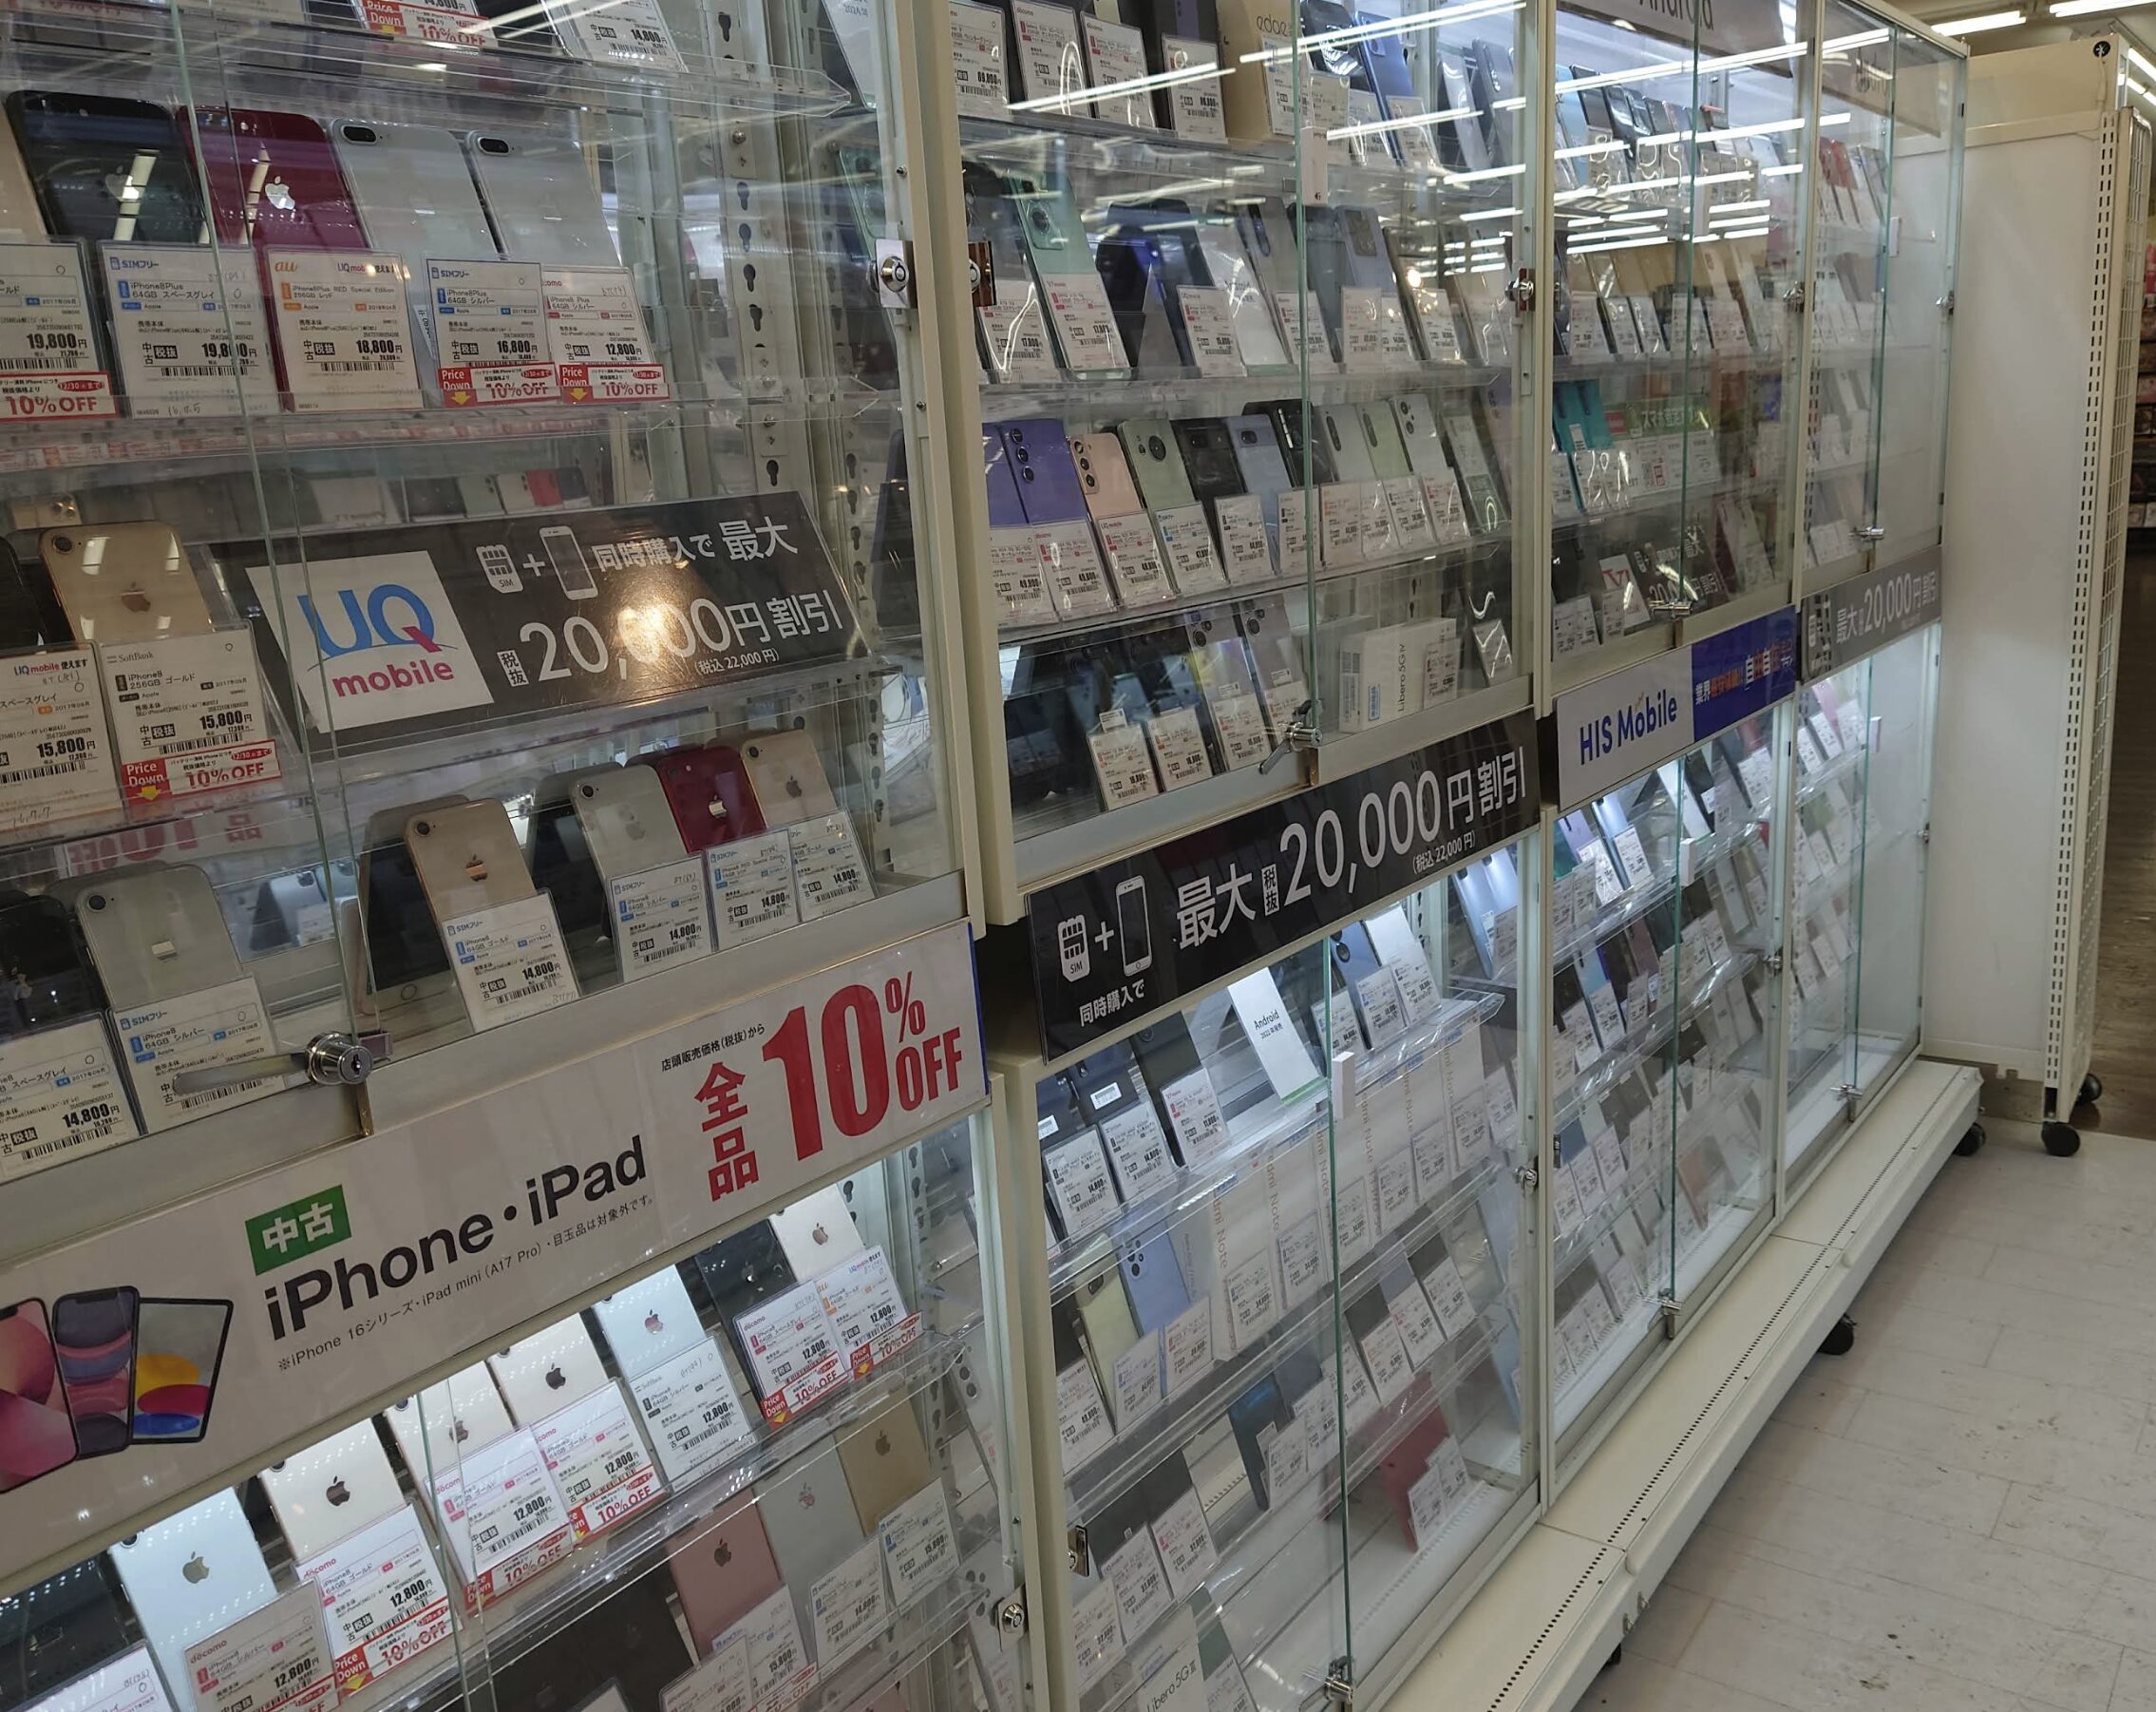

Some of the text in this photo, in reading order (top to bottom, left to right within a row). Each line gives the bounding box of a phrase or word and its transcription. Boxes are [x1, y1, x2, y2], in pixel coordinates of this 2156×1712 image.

[370, 11, 401, 26] Down
[274, 262, 297, 272] au
[338, 263, 350, 273] UQ
[162, 291, 215, 299] スペースグレイ
[28, 333, 87, 350] 19,800円
[304, 339, 313, 360] 中古
[313, 343, 335, 355] 税抜
[356, 340, 403, 354] 18,800円
[452, 340, 461, 359] 中古
[497, 340, 538, 353] 16,800円
[606, 344, 642, 354] 12,800円
[142, 342, 153, 365] 中古
[154, 345, 178, 359] 税抜
[442, 371, 464, 379] Price
[562, 367, 582, 376] Price
[444, 381, 470, 390] Down
[563, 378, 587, 387] Down
[594, 515, 799, 572] 同時購入で 最大
[499, 578, 515, 589] SIM
[296, 583, 437, 657] UQ
[1837, 604, 1857, 644] 最大
[118, 652, 154, 662] SoftBank
[14, 659, 87, 676] UQ mobile 使えます
[128, 671, 162, 681] iPhone8
[497, 650, 530, 688] 税抜
[130, 673, 195, 690] 256GB ゴールド
[331, 659, 455, 697] mobile
[0, 694, 57, 709] スペースグレイ
[199, 710, 253, 730] 15,800円
[1580, 689, 1678, 766] HIS Mobile
[140, 725, 151, 746] 中古
[151, 724, 176, 739] 税抜
[36, 736, 96, 758] 15,800円
[126, 762, 158, 775] Price
[128, 774, 164, 788] Down
[833, 869, 861, 885] 14,800円
[762, 891, 791, 909] 14,800円
[1176, 866, 1257, 951] 最大
[1260, 865, 1279, 917] 税抜
[669, 923, 702, 942] 14,800円
[522, 961, 561, 980] 14,800円
[1069, 961, 1084, 975] SIM
[1079, 980, 1144, 1027] 同時購入で
[1254, 1010, 1279, 1031] Android
[142, 1027, 177, 1041] iPhone8
[173, 1028, 205, 1042] シルバー
[661, 1023, 766, 1073] 店頭販売価格(税抜)から
[762, 971, 926, 1161] 10%
[895, 1027, 963, 1112] OFF
[11, 1067, 66, 1088] スペースグレイ
[62, 1103, 121, 1128] 14,800円
[694, 1061, 759, 1202] 全品
[261, 1200, 335, 1255] 中古
[455, 1271, 482, 1292] mini
[485, 1256, 514, 1283] (A17
[744, 1316, 766, 1331] docomo
[803, 1340, 830, 1360] 12,800円
[764, 1395, 780, 1408] Price
[766, 1401, 785, 1417] Down
[703, 1402, 733, 1423] 12,800円
[604, 1451, 640, 1475] 12,800円
[513, 1495, 553, 1522] 12,800円
[350, 1563, 372, 1581] ゴールド
[389, 1579, 433, 1607] 12,800円
[343, 1623, 356, 1642] 中古
[191, 1640, 227, 1664] docomo
[334, 1652, 358, 1669] Price
[274, 1657, 319, 1688] 12,800円
[337, 1661, 366, 1682] Down
